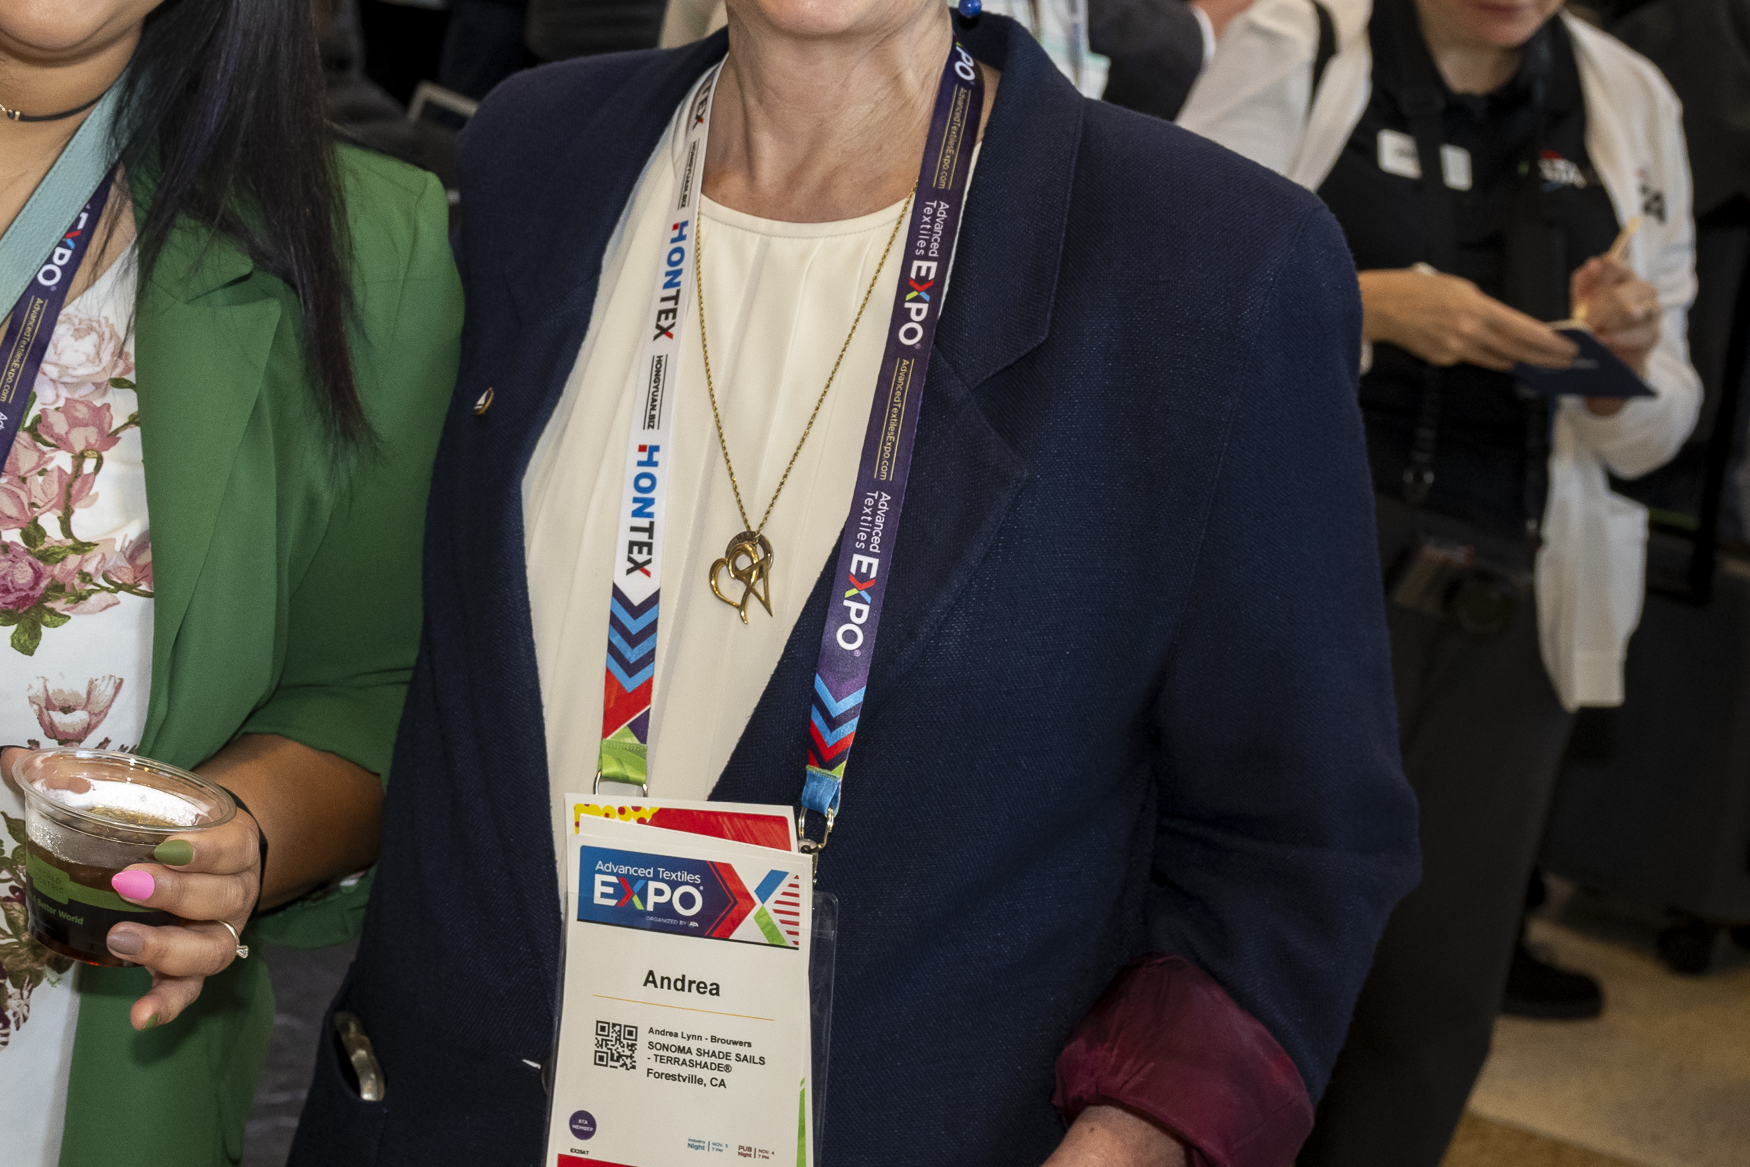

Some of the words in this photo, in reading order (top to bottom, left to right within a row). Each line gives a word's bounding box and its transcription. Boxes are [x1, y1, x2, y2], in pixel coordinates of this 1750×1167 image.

[954, 45, 976, 81] PO
[938, 87, 967, 189] AdvancedTextilesExpo.com
[915, 200, 937, 256] Textiles
[928, 200, 950, 257] Advanced
[653, 220, 689, 341] HONTEX
[0, 297, 44, 402] AdvancedTextilesExpo.com
[647, 355, 664, 430] HONGYUAN.BIZ
[879, 358, 910, 481] AdvancedTextilesExpo.com
[625, 444, 661, 578] HONTEX
[855, 490, 879, 549] Textiles
[869, 491, 891, 554] Advanced
[595, 860, 654, 878] Advanced
[657, 867, 701, 884] Textiles
[37, 898, 57, 915] Better
[58, 910, 84, 926] World
[645, 915, 678, 925] ORGANIZED
[643, 969, 721, 997] Andrea
[647, 1040, 693, 1056] SONOMA
[695, 1047, 732, 1061] SHADE
[734, 1053, 766, 1066] SAILS
[648, 1026, 679, 1038] Andrea
[680, 1031, 703, 1042] Lynn
[710, 1035, 753, 1048] Brouwers
[646, 1067, 707, 1088] Forestville,
[709, 1076, 727, 1089] CA
[653, 1053, 733, 1074] TERRASHADE®
[572, 1124, 594, 1132] MEMBER
[687, 1143, 705, 1151] Night
[738, 1144, 753, 1153] PUB
